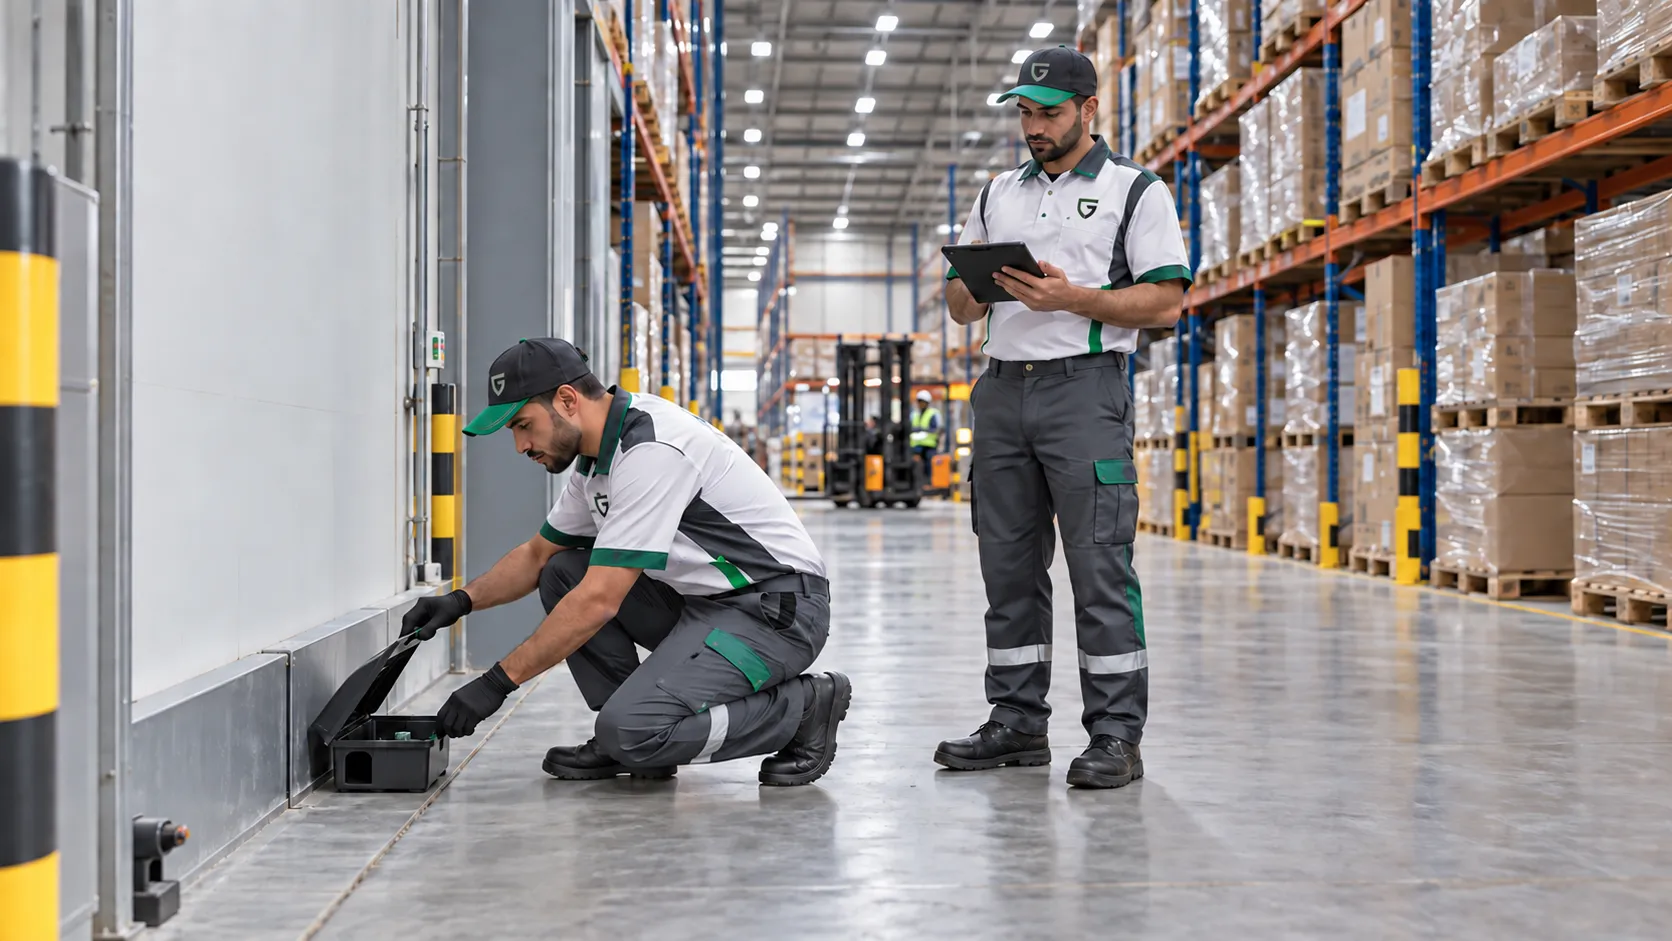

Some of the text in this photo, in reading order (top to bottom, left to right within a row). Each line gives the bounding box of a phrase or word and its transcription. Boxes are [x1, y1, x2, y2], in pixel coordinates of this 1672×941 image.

[1031, 63, 1050, 82] G
[1077, 198, 1099, 219] G
[491, 372, 505, 397] G
